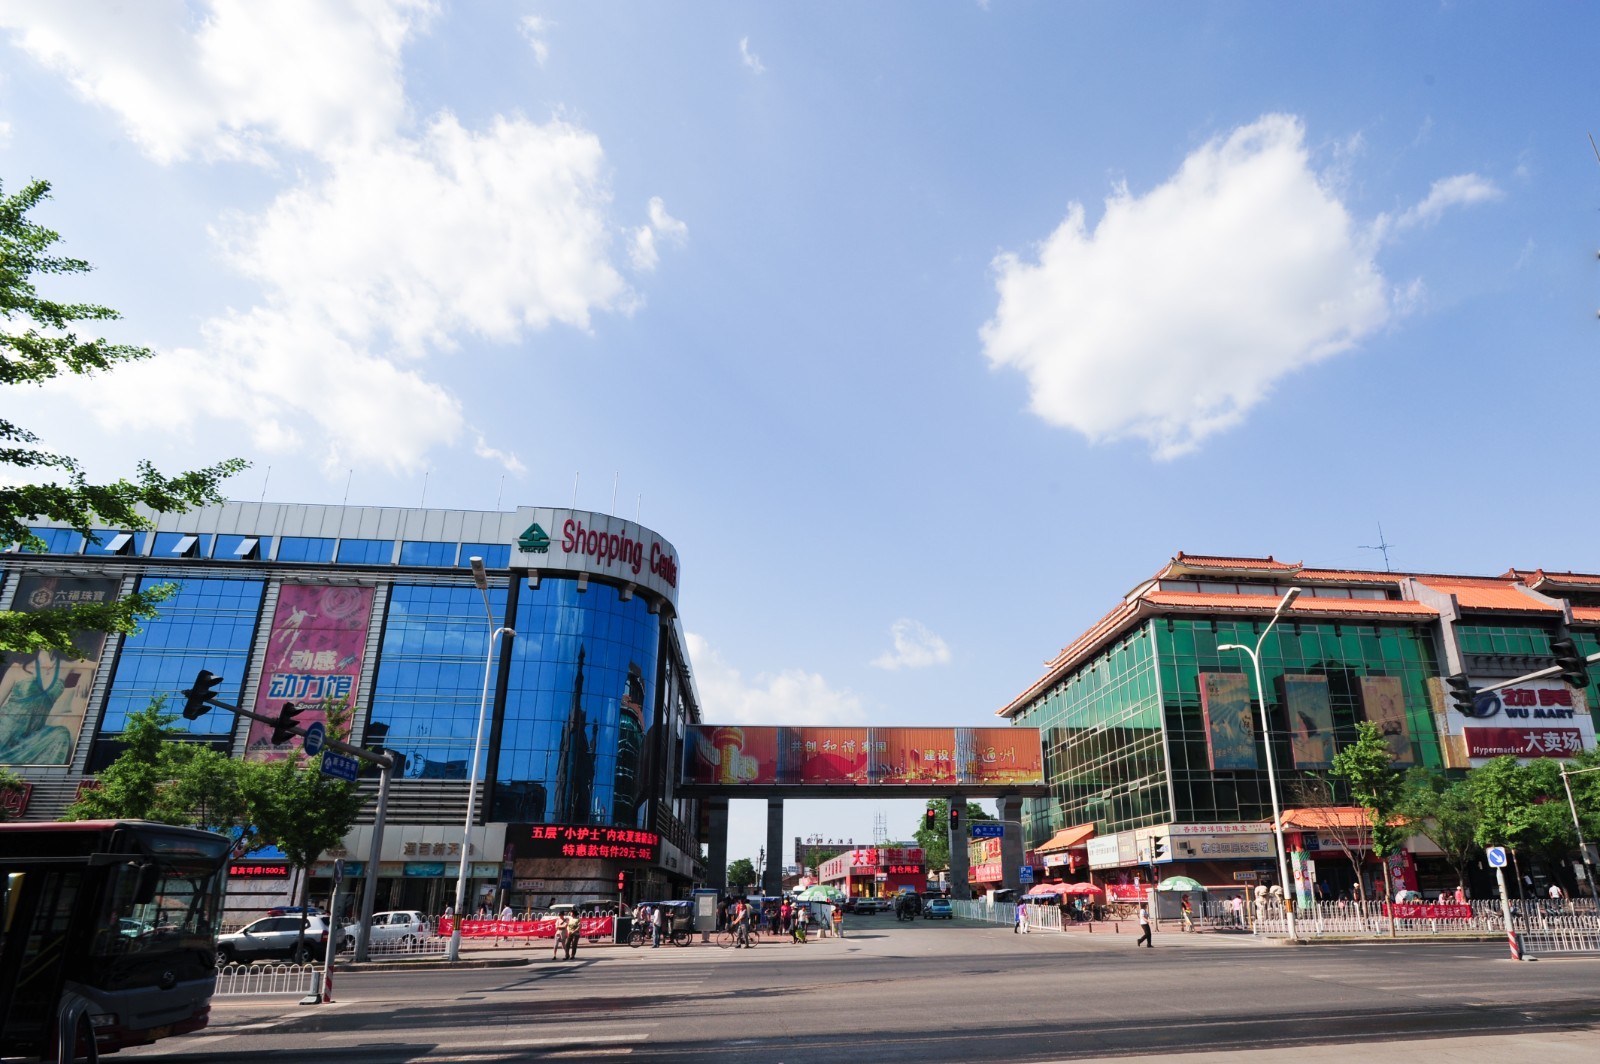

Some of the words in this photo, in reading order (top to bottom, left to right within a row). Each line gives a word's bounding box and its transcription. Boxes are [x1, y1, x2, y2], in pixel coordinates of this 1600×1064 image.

[561, 518, 643, 575] Shopping
[289, 649, 338, 671] 动感
[267, 673, 354, 700] 动力馆
[297, 702, 320, 710] Sport
[1501, 688, 1573, 707] 物美
[1505, 708, 1530, 719] WU
[1533, 708, 1575, 719] MART
[1473, 746, 1524, 756] Hypermarket
[1523, 731, 1581, 753] 大卖场
[229, 866, 287, 875] 最高可得1500元
